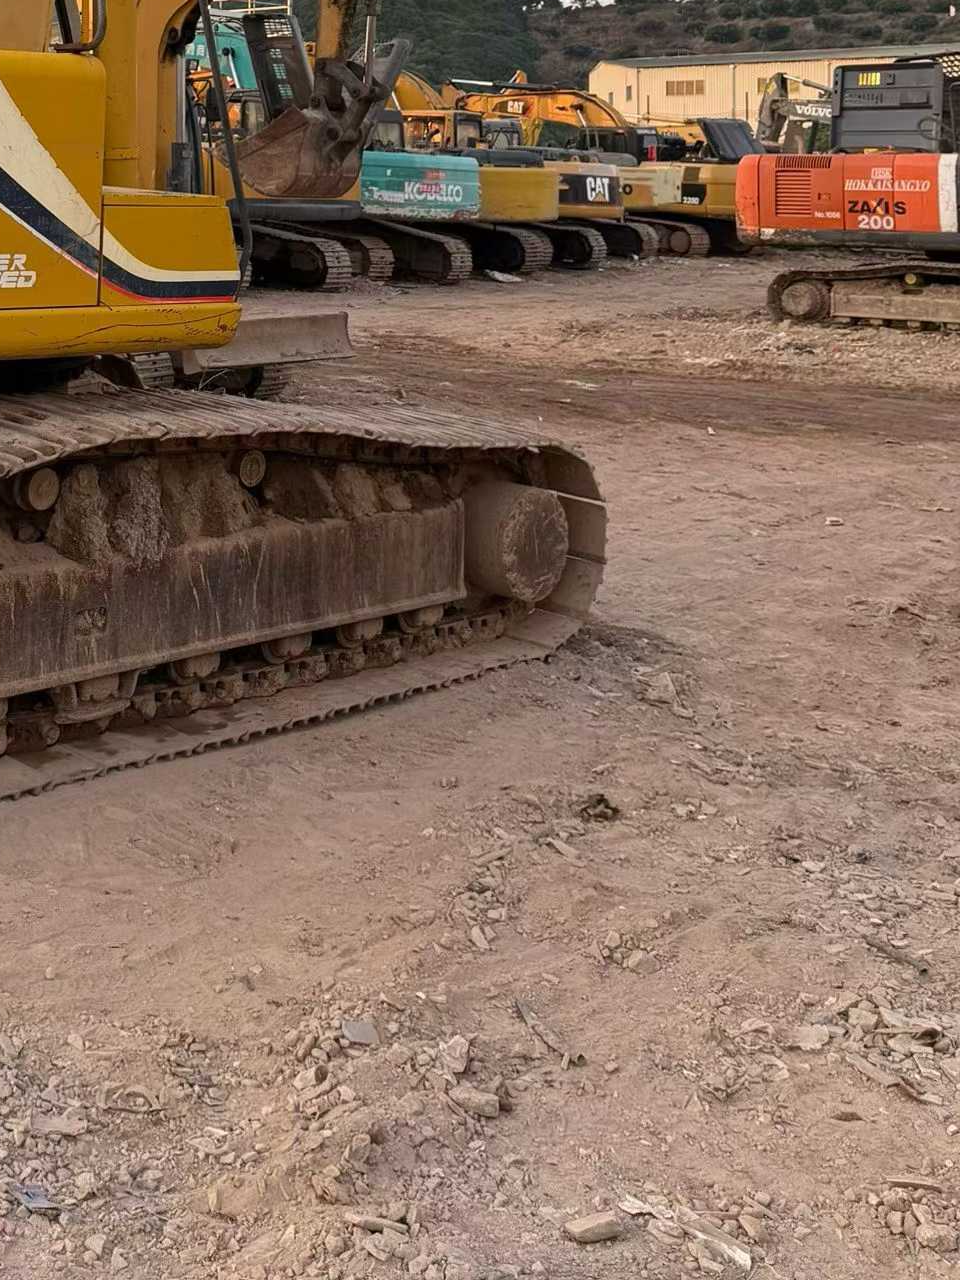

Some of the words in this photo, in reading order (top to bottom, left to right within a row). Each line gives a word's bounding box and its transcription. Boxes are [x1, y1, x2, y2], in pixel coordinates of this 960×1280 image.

[507, 100, 525, 113] CAT
[586, 176, 610, 202] CAT
[848, 198, 907, 215] ZAXIS
[858, 215, 895, 229] 200
